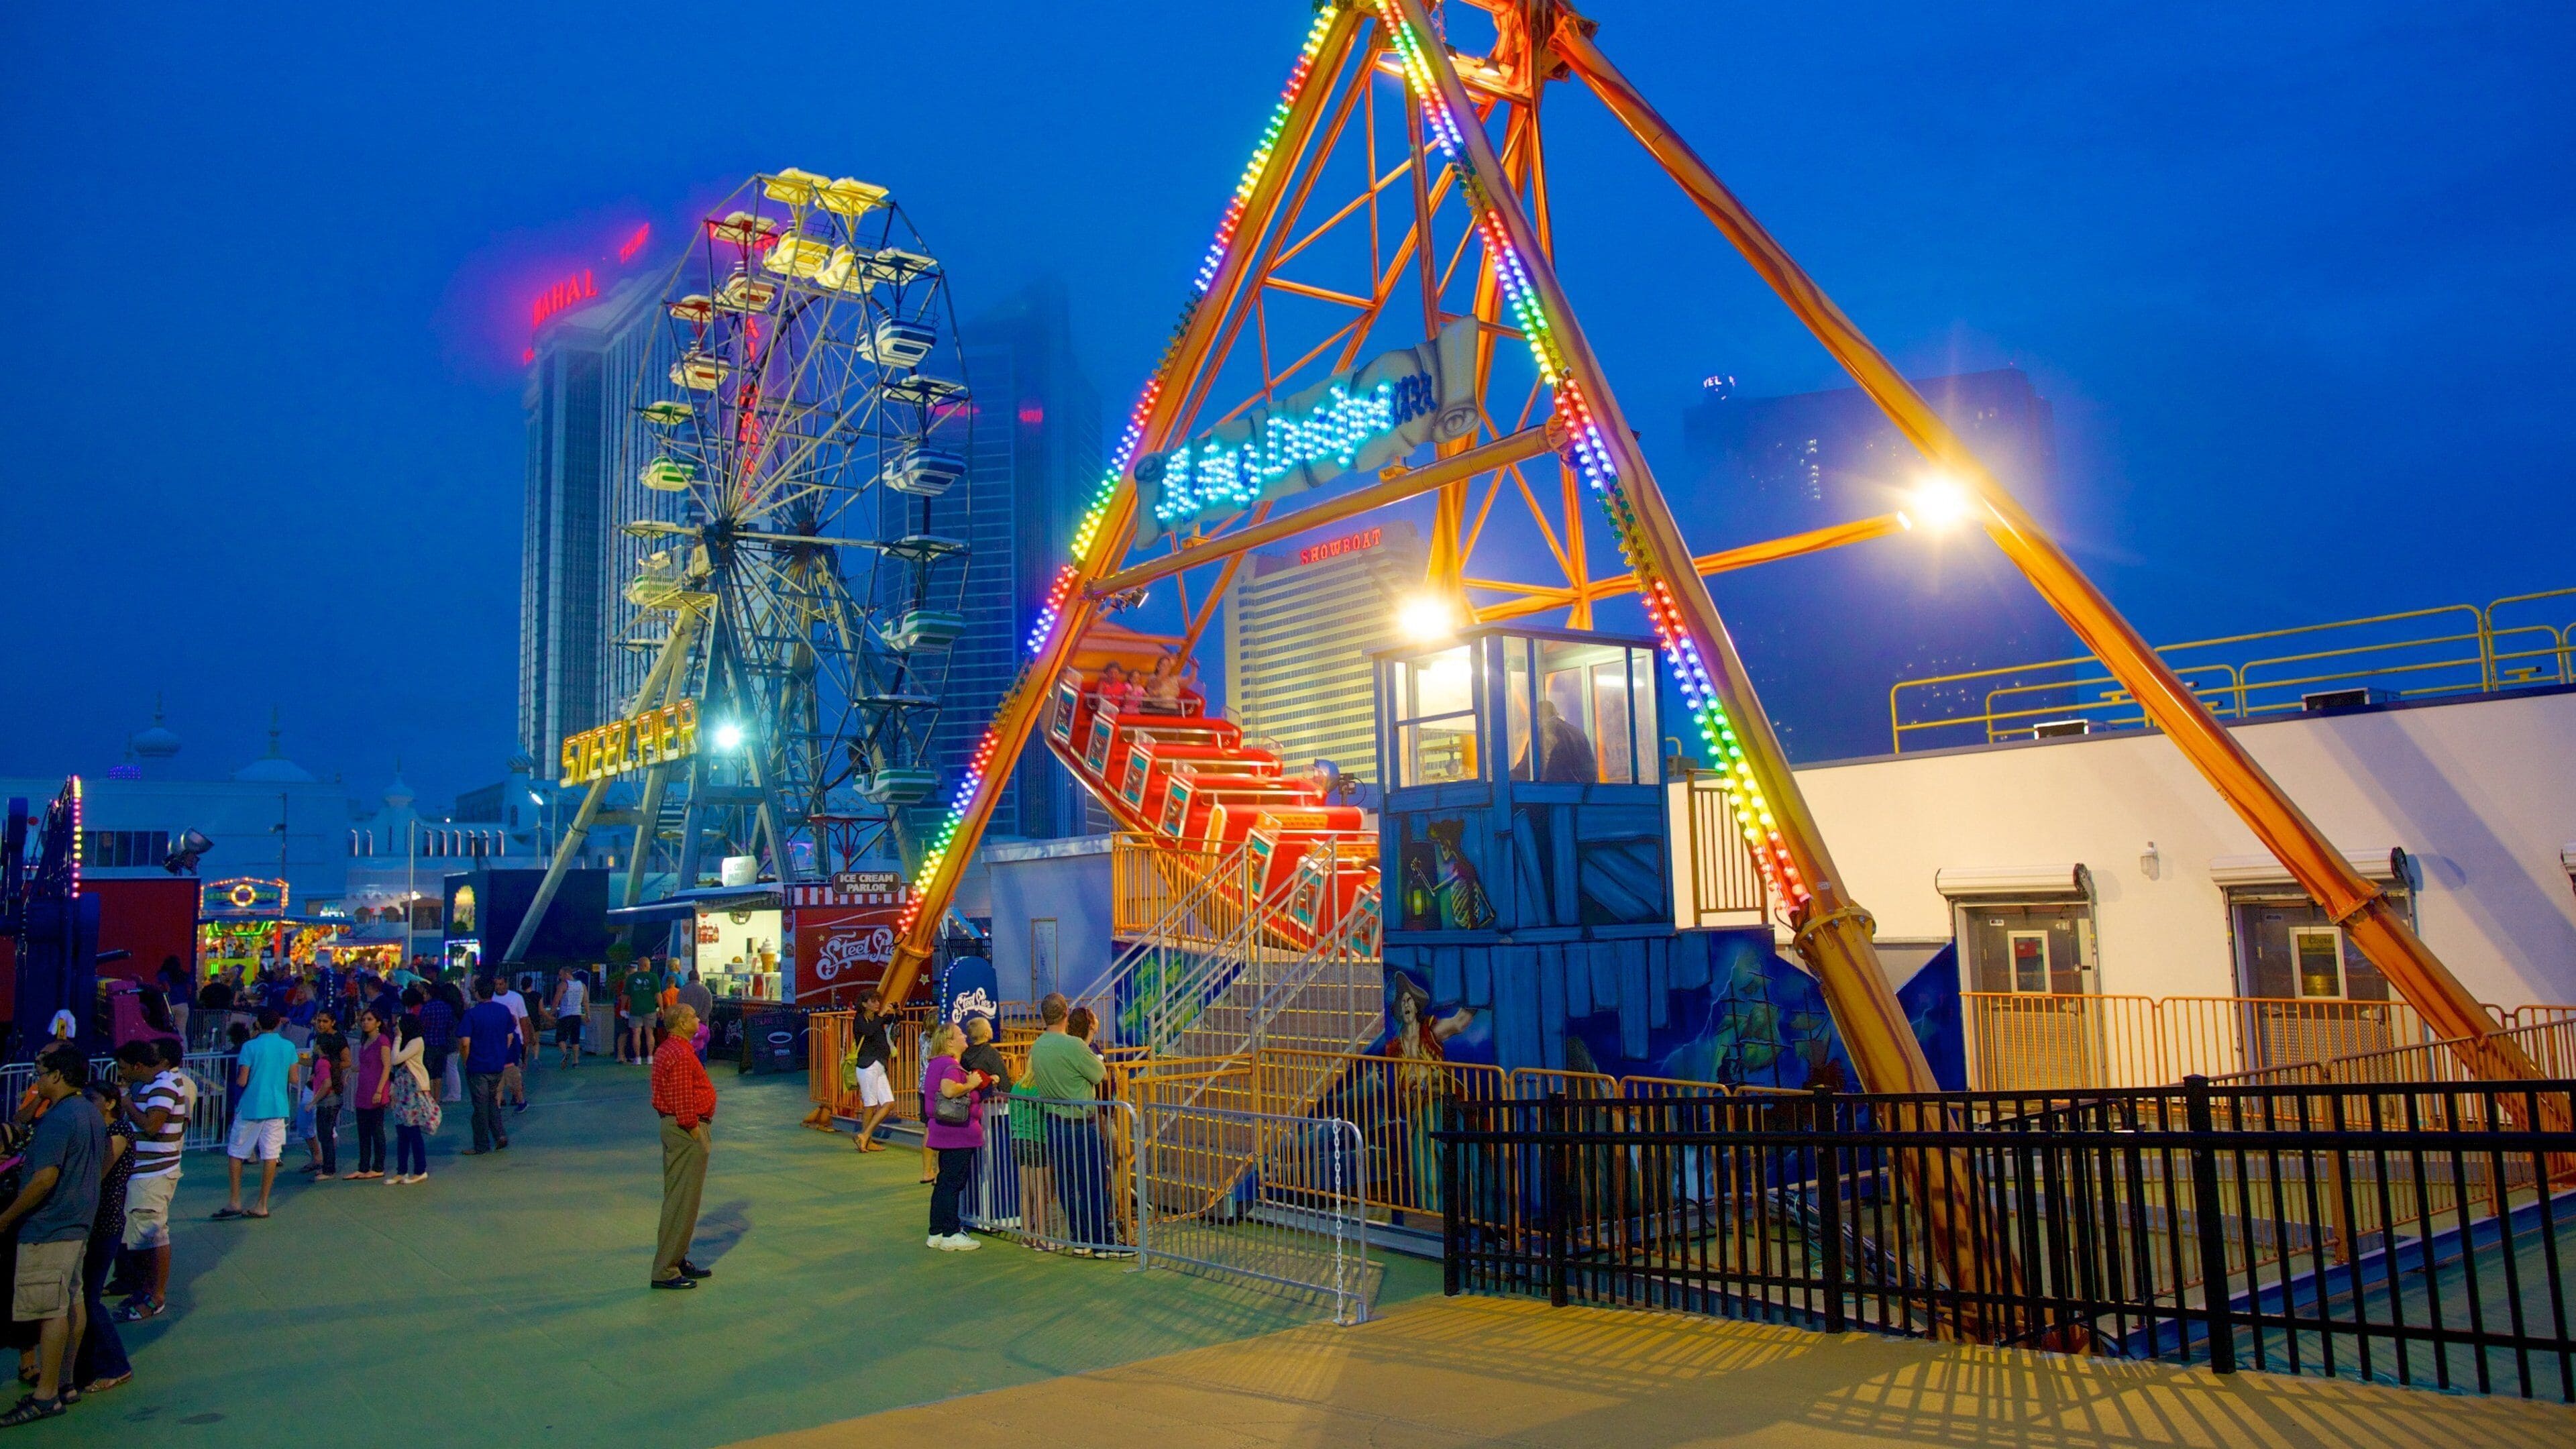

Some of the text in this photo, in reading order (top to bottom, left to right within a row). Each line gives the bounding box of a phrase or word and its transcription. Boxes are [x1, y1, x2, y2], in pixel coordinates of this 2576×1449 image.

[1300, 528, 1382, 565] SHOWBOAT
[559, 698, 698, 788] STEEL PIER
[840, 874, 894, 883] ICE CREAM
[847, 883, 887, 892] PARLOR
[816, 928, 895, 980] Steel Pie
[952, 990, 976, 1024] Steel
